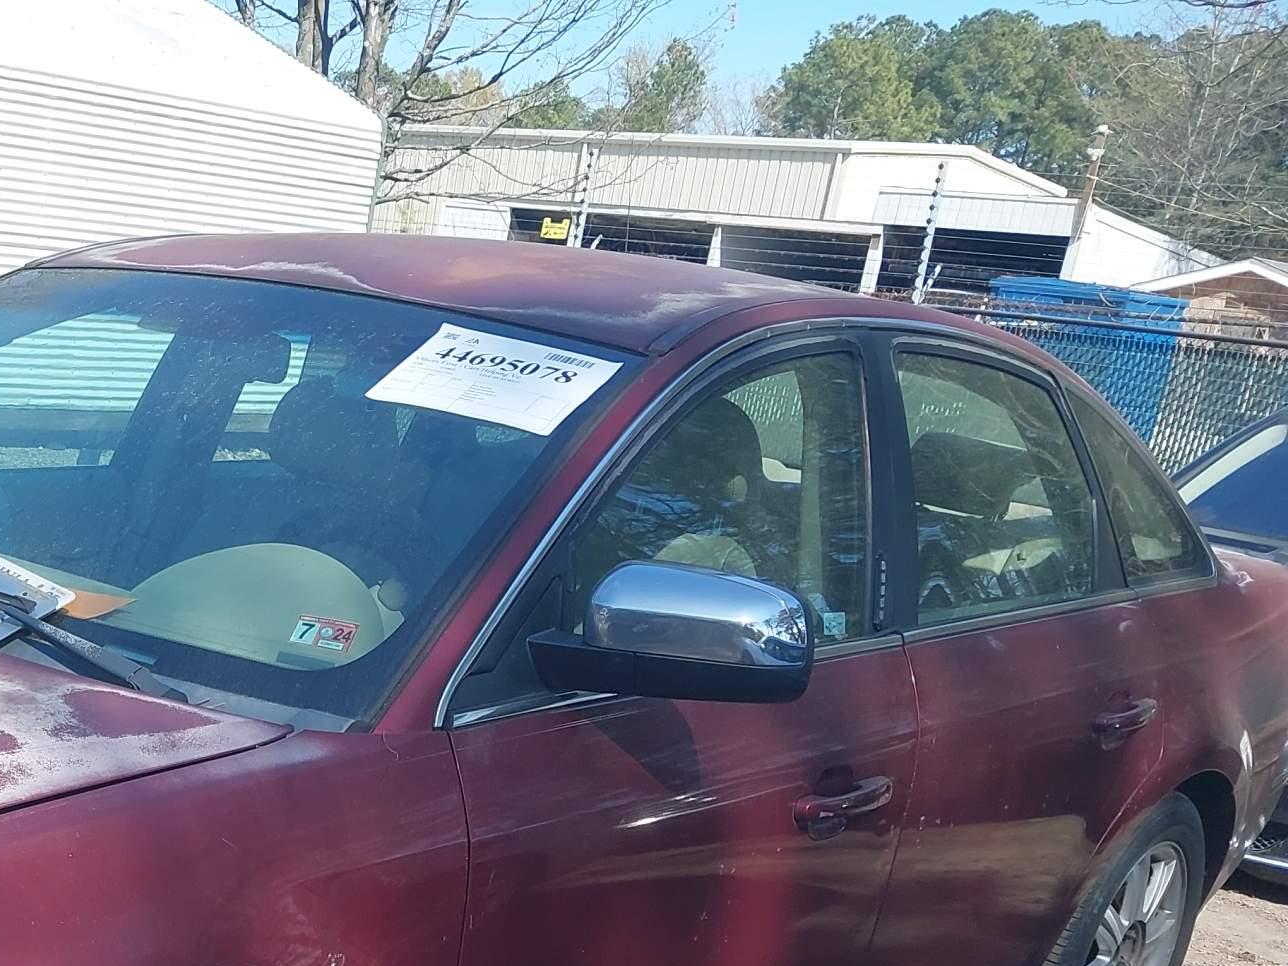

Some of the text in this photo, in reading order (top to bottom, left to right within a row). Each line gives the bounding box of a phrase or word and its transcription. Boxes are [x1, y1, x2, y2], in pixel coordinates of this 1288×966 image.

[435, 346, 578, 384] 44695078
[298, 622, 354, 643] 7 24
